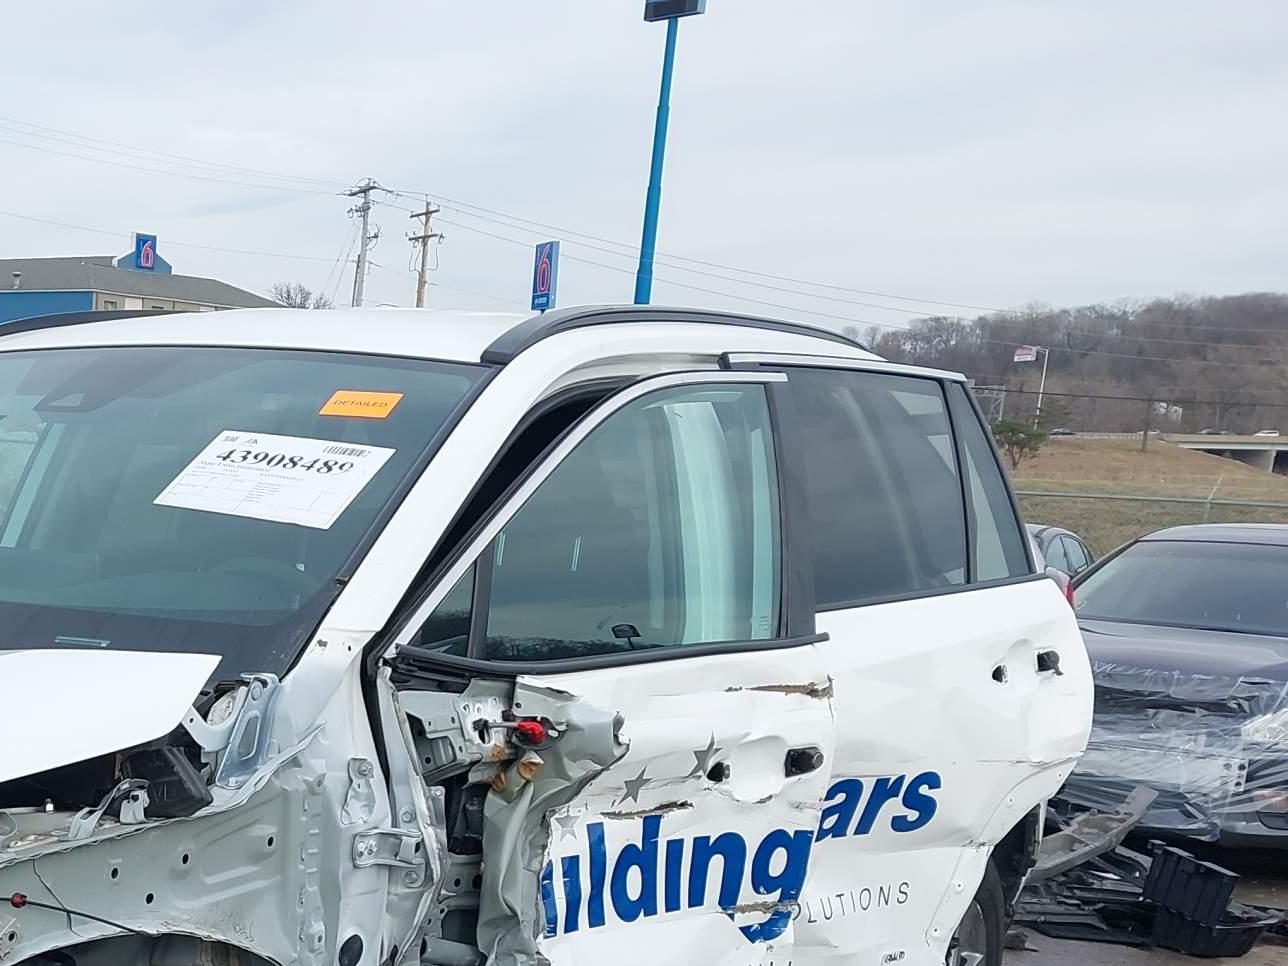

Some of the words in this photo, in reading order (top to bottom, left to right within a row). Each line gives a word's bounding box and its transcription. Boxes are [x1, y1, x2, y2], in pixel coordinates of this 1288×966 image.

[141, 240, 154, 268] 6
[537, 244, 550, 293] 6
[332, 398, 388, 409] DETAILED
[215, 448, 355, 475] 43908489
